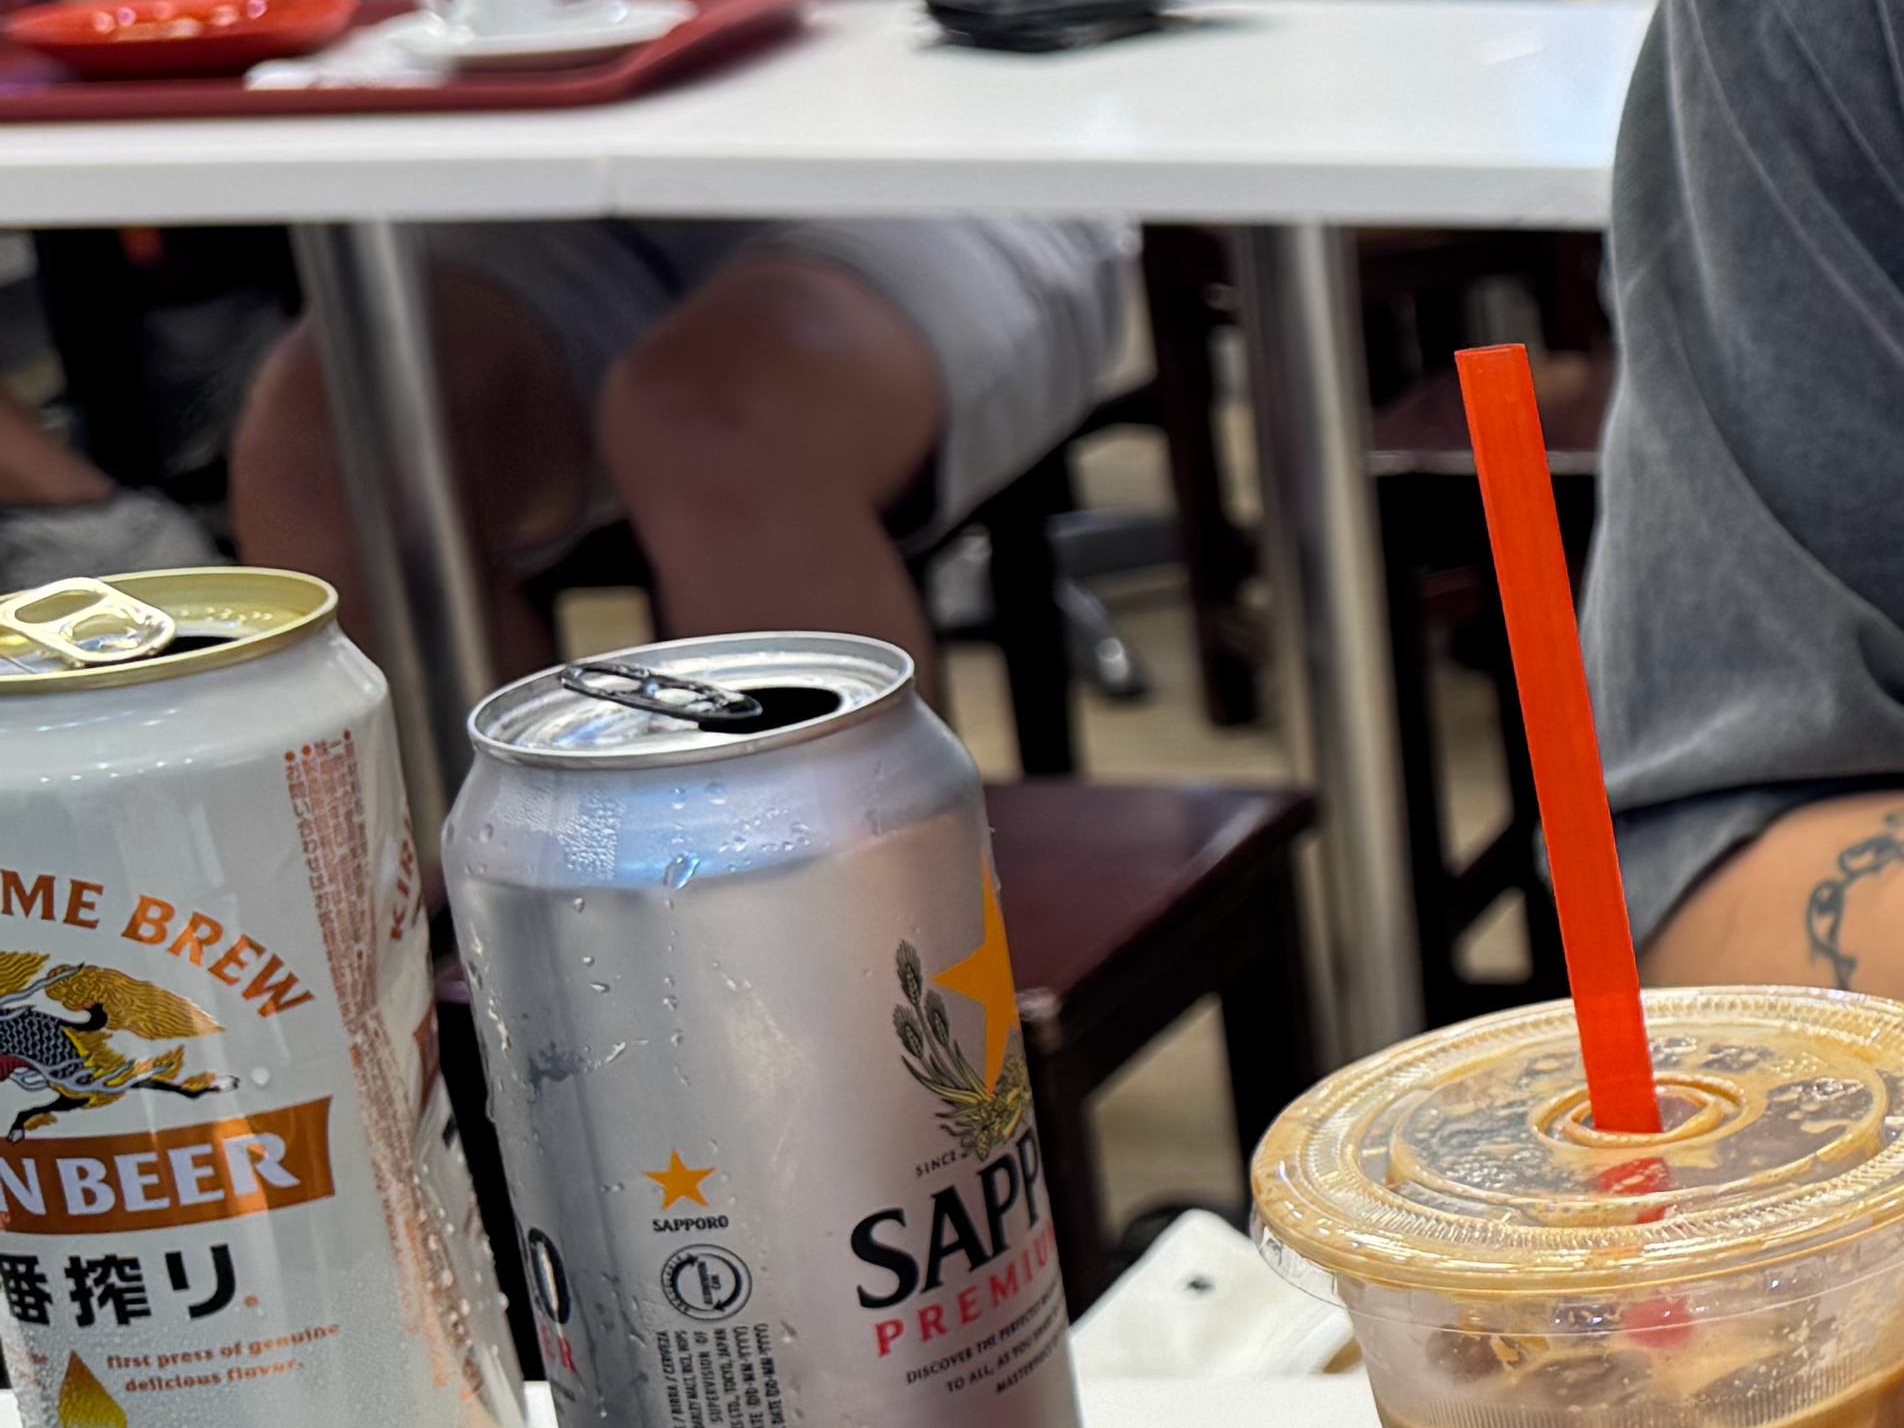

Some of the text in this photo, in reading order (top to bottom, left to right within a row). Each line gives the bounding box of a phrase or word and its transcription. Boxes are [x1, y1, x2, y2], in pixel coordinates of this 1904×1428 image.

[121, 894, 315, 1018] BREW
[56, 1132, 301, 1215] BEER
[652, 1215, 729, 1233] SAPPORO
[106, 1323, 341, 1371] first press of genuine
[694, 1331, 708, 1344] OF
[124, 1370, 222, 1393] delicious
[906, 1346, 973, 1384] DISCOVER
[698, 1351, 723, 1423] SUPERVISION
